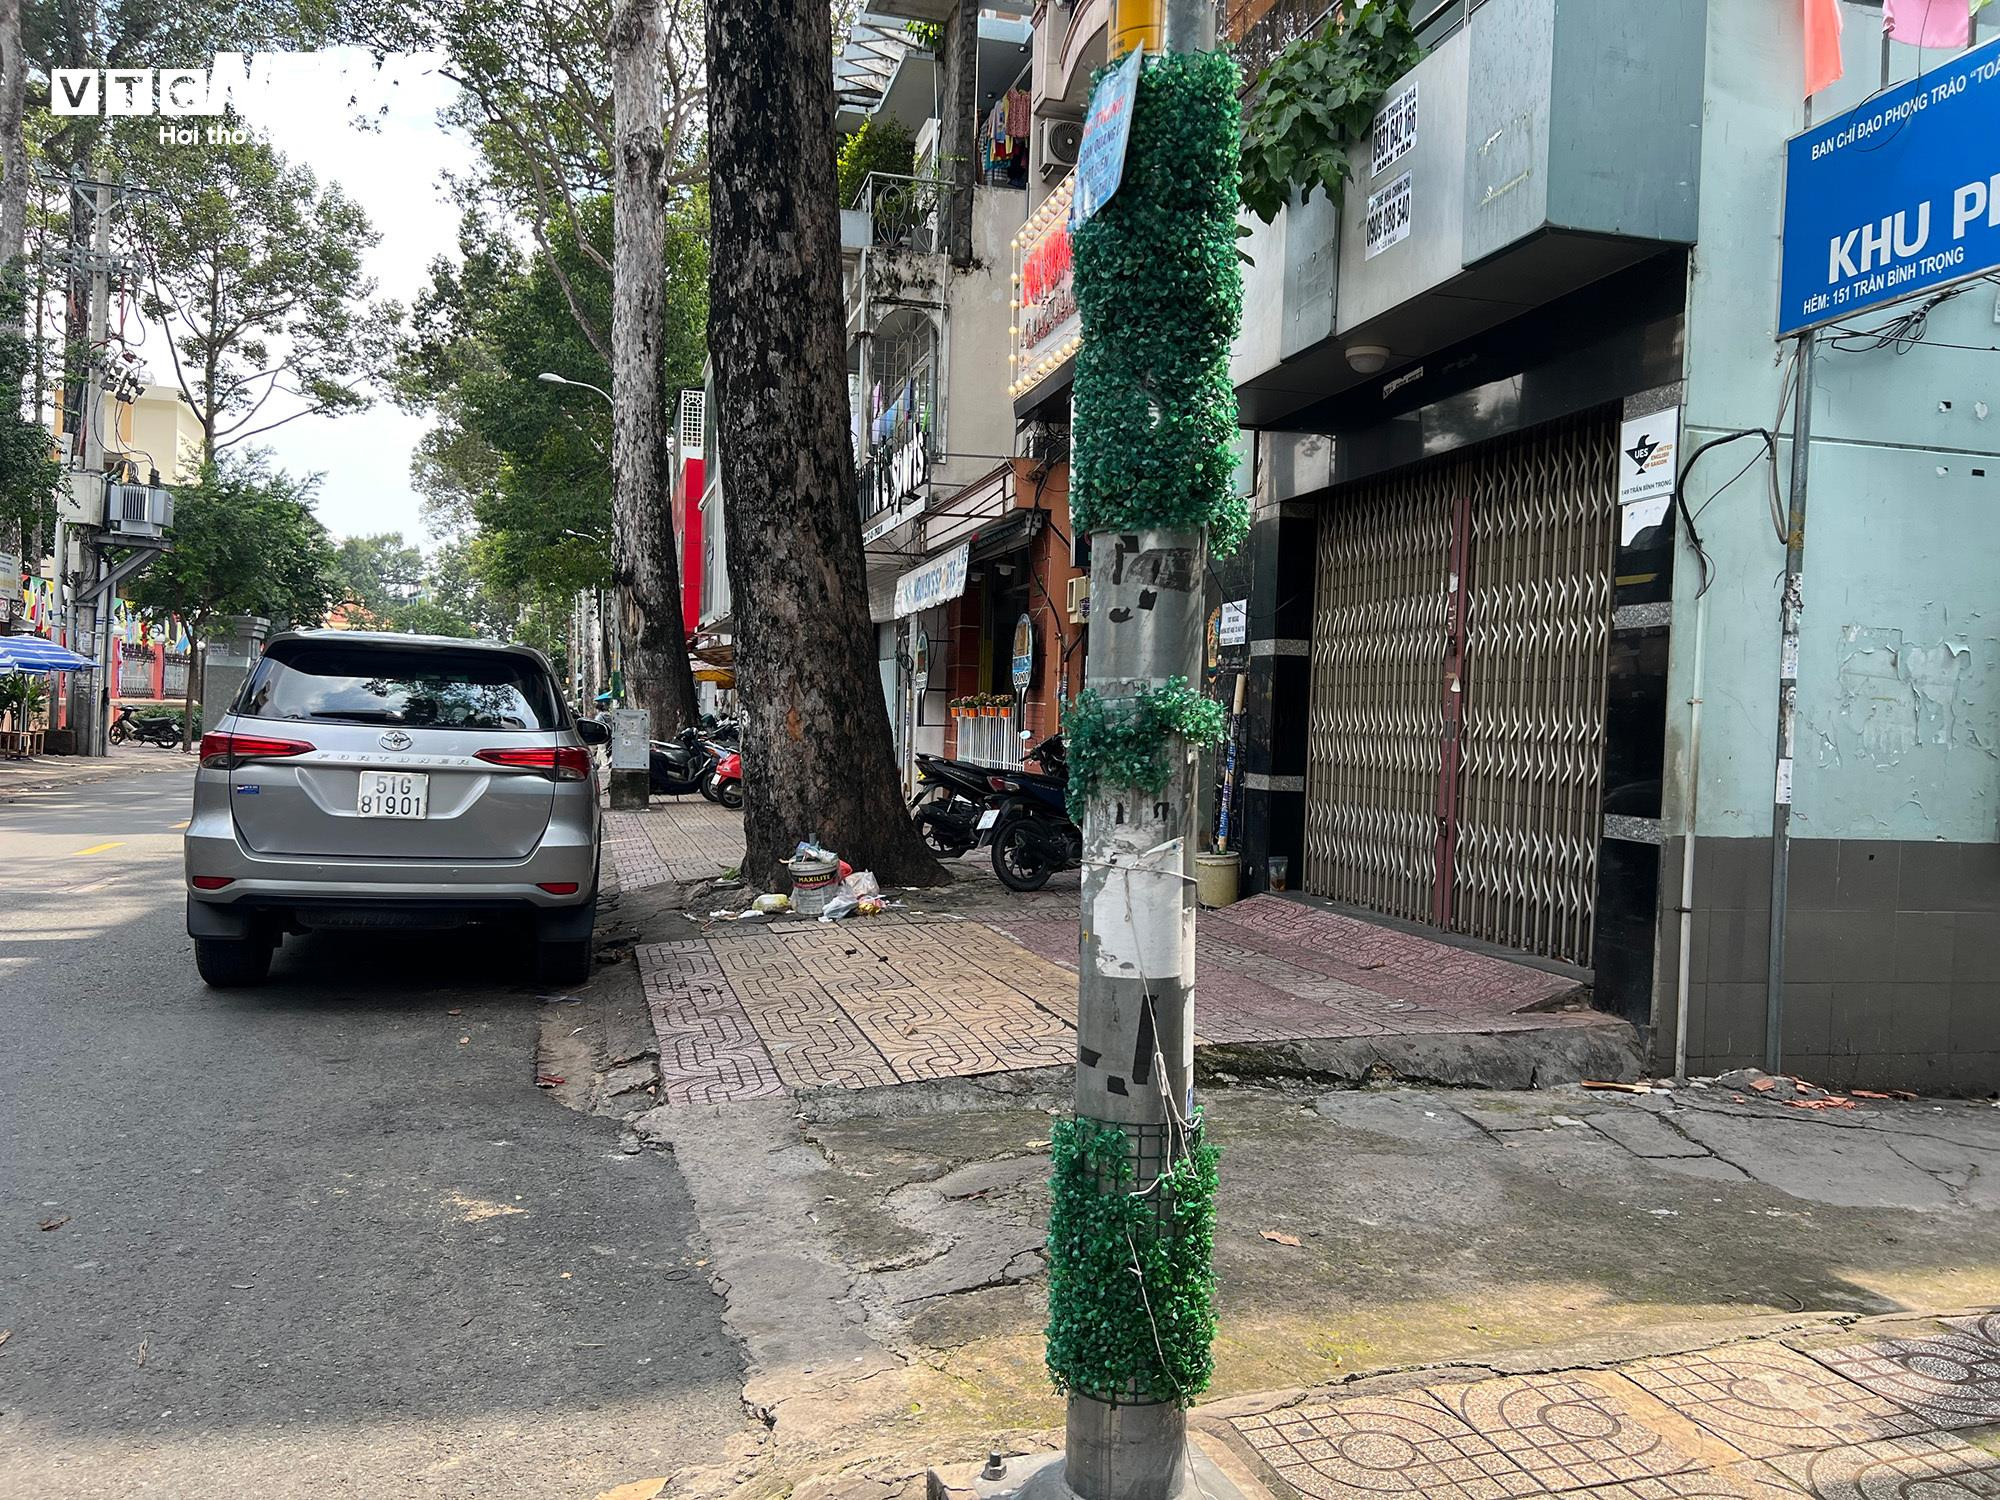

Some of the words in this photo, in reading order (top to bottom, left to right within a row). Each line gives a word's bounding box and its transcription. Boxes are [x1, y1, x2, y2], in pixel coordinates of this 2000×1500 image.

[1374, 111, 1387, 131] CHO
[1812, 137, 1834, 160] BAN
[1858, 113, 1882, 140] ĐẠO
[1885, 95, 1928, 126] PHONG
[1931, 73, 1967, 103] TRÀO
[1373, 122, 1389, 163] 0931
[1390, 112, 1403, 150] 642
[1376, 154, 1393, 173] ANH
[1828, 200, 1931, 285] KHU
[1833, 285, 1850, 305] 151
[1887, 262, 1917, 287] BÌNH
[1919, 246, 1965, 275] TRỌNG
[1635, 448, 1648, 459] UES
[317, 753, 470, 766] FORTUNER
[376, 775, 412, 796] 51G
[361, 794, 421, 817] 819.01
[798, 873, 831, 883] MAXILITE
